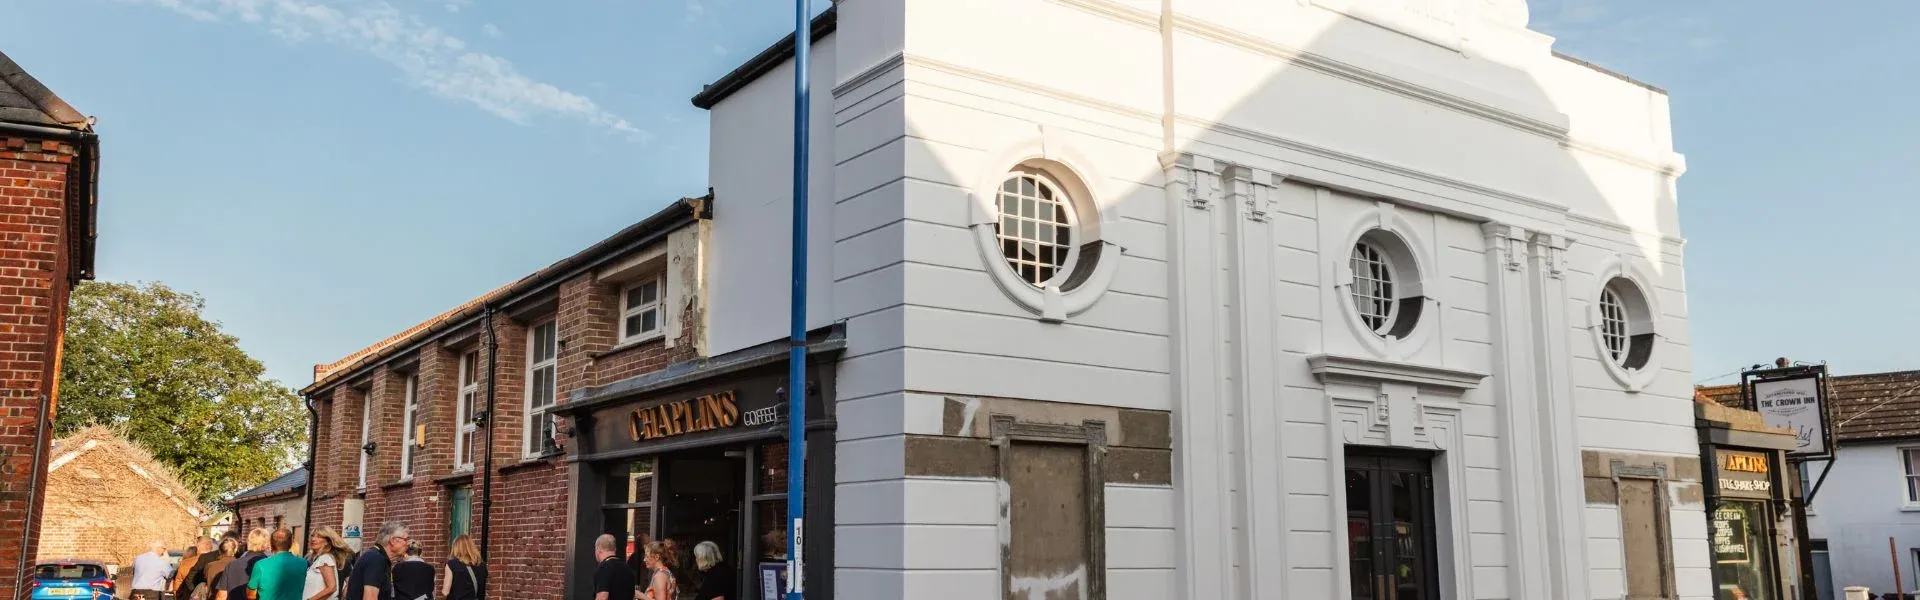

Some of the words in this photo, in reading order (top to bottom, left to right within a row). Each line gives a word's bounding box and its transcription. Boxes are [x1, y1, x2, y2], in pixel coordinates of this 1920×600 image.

[1761, 399, 1773, 408] THE
[1775, 398, 1802, 407] CROWN
[1803, 396, 1816, 404] INN
[629, 390, 739, 442] CHAPLINS
[1724, 454, 1768, 473] APLINS
[1718, 478, 1734, 490] TTLE
[1753, 479, 1770, 491] SHOP
